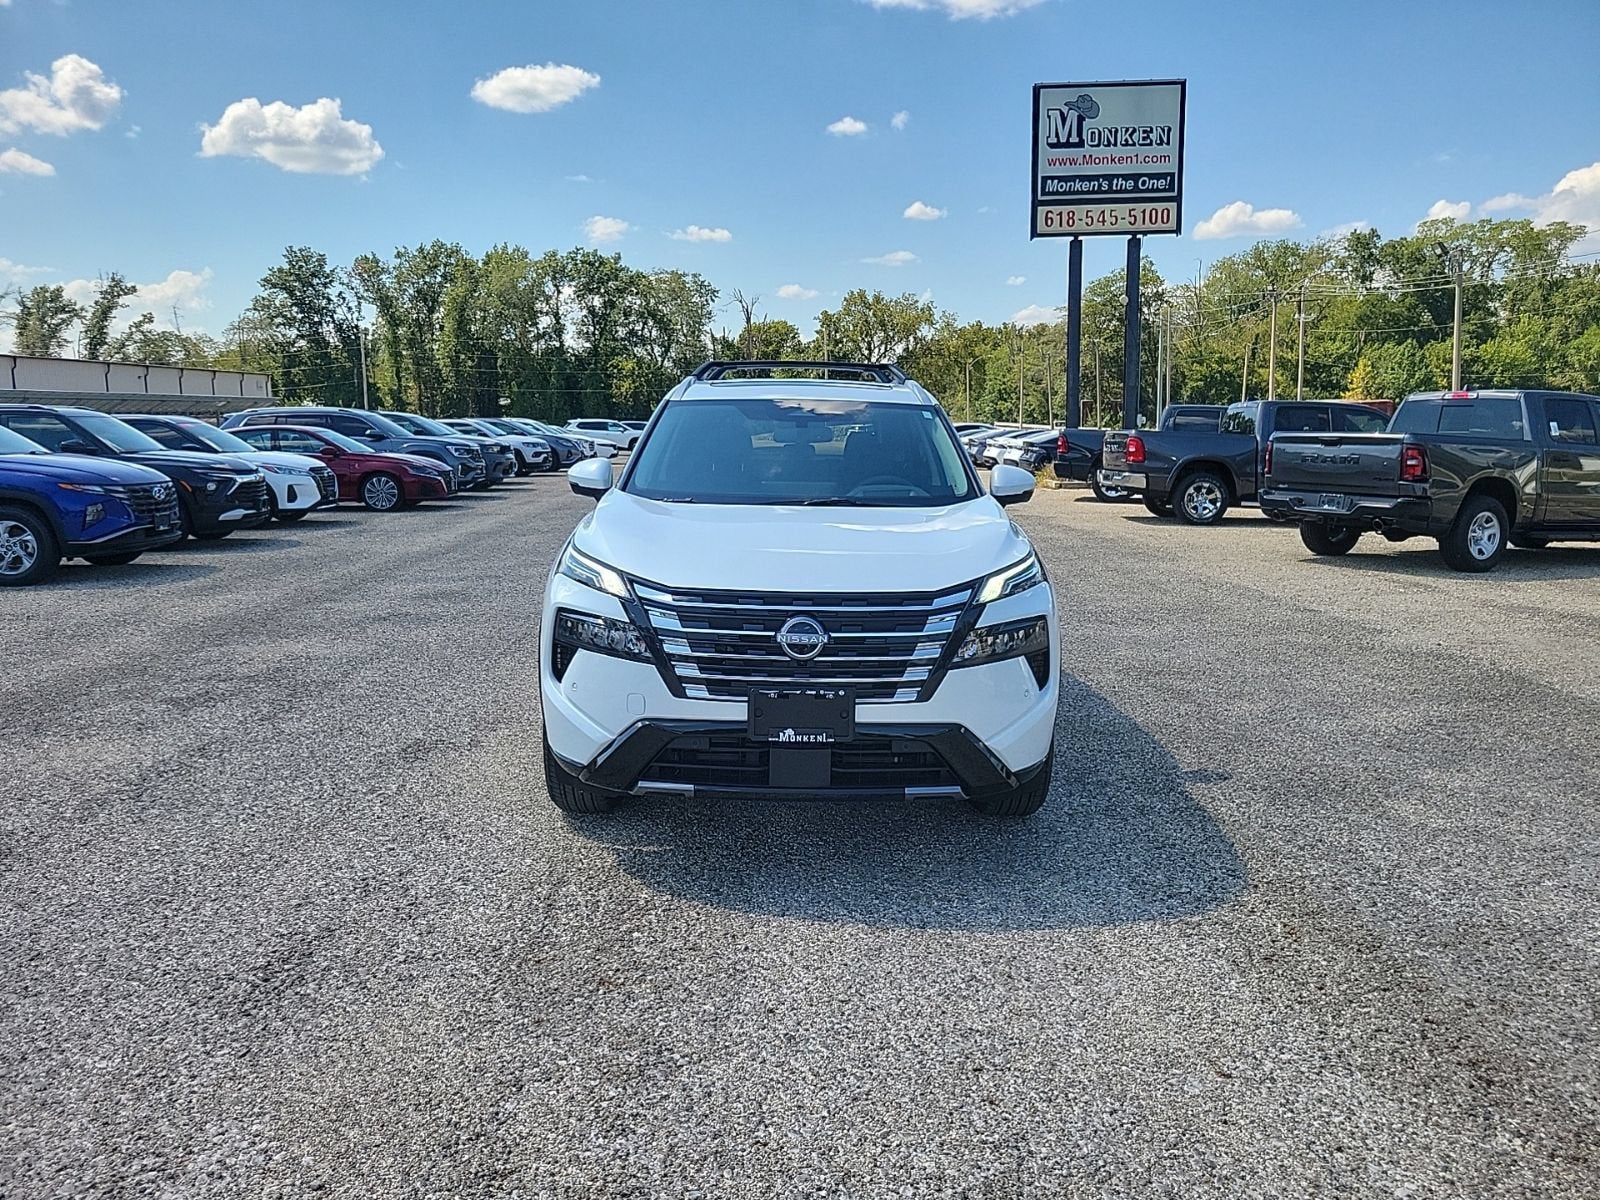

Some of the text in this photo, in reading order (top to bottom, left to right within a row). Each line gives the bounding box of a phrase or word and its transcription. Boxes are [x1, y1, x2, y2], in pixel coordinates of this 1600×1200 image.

[1047, 108, 1172, 148] MONKEN
[1047, 153, 1171, 167] www.Monken1.com
[1045, 176, 1170, 192] Monken's the One!
[1044, 207, 1171, 228] 618-545-5100
[778, 635, 828, 643] NISSAN
